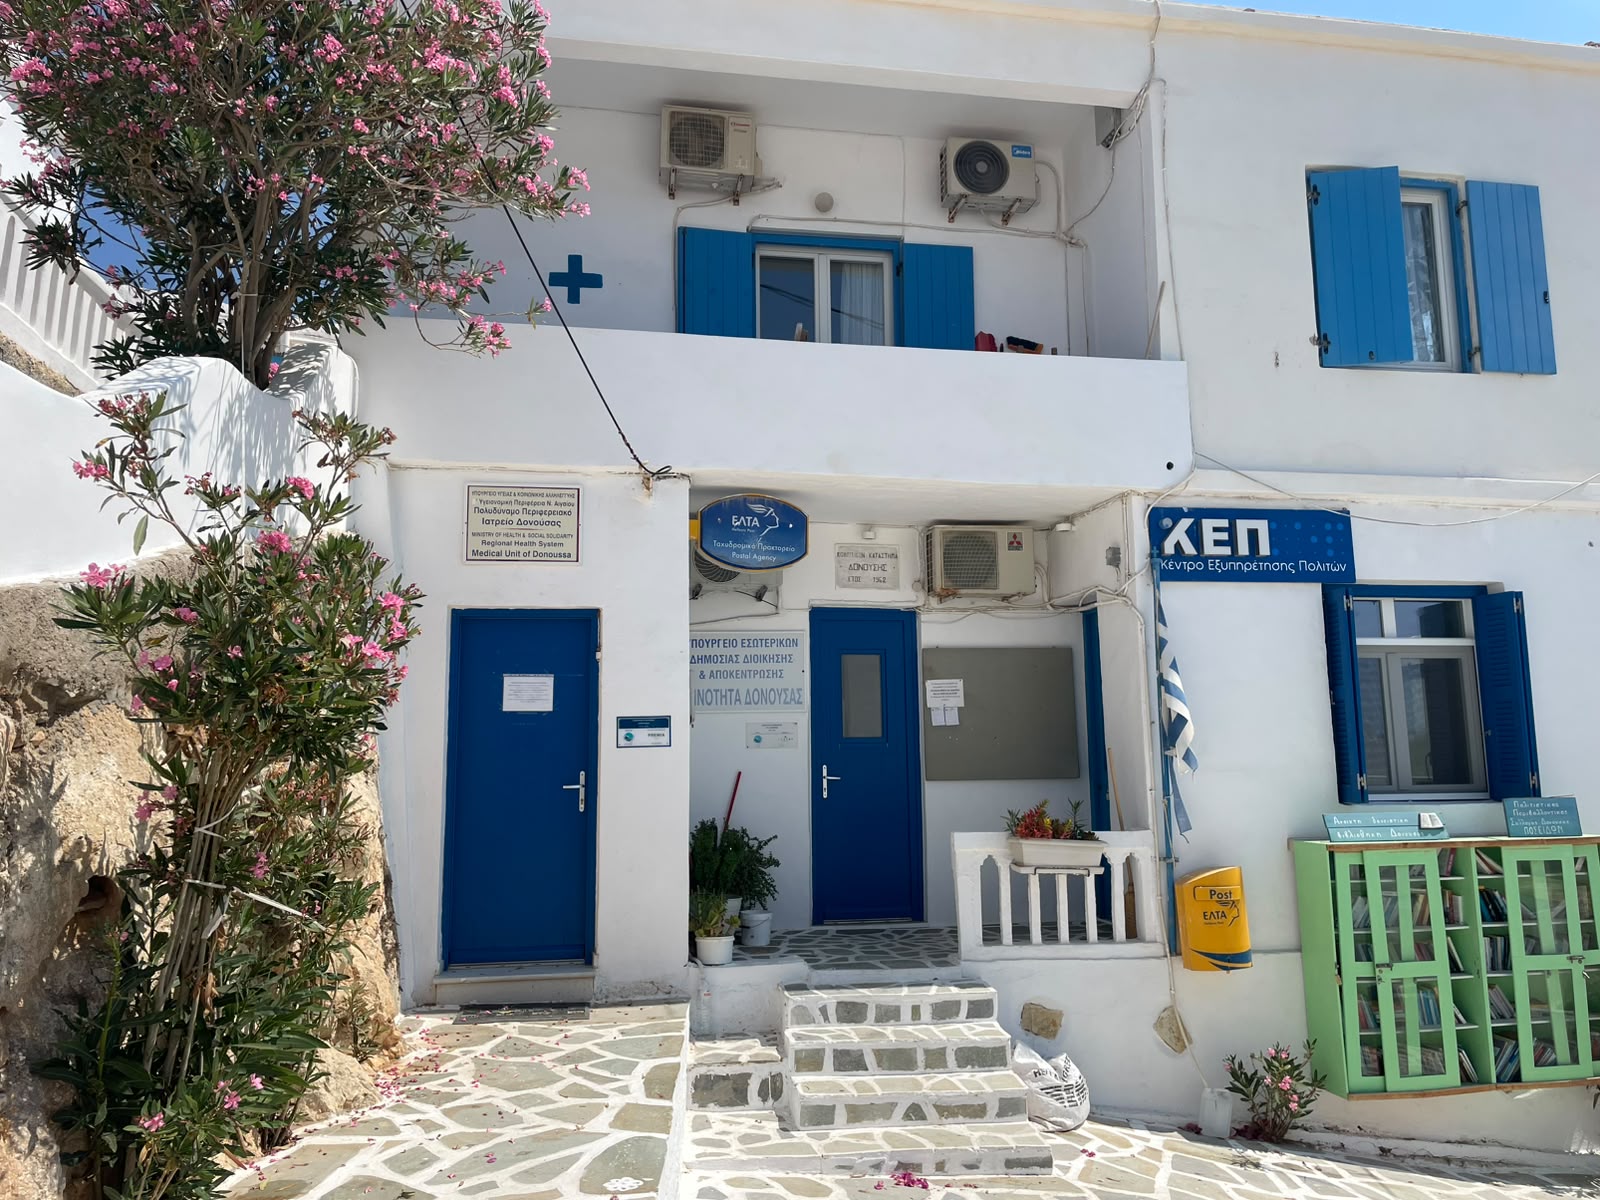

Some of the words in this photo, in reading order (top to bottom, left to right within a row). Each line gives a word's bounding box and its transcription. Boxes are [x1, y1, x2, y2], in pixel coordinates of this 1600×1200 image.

[474, 507, 520, 516] Πολυδύναμο
[522, 507, 572, 517] Περιφερειακό
[482, 517, 514, 527] Ιατρείο
[516, 518, 561, 528] Δονούσας
[732, 515, 760, 527] ΕΛΤΑ
[1161, 517, 1271, 556] ΚΕΠ
[752, 553, 776, 562] Agency
[1161, 559, 1204, 572] Κέντρο
[1208, 560, 1295, 573] Εξυπηρέτησης
[1299, 560, 1346, 572] Πολιτών
[690, 639, 738, 648] ΠΟΥΡΓΕΙΟ
[741, 638, 798, 648] ΕΣΩΤΕΡΙΚΩΝ
[690, 655, 740, 664] ΔΗΜΟΣΙΑΣ
[743, 654, 793, 663] ΔΙΟΙΚΗΣΗΣ
[699, 671, 706, 679] &
[709, 669, 784, 679] ΑΠΟΚΕΝΤΡΩΣΗΣ
[744, 688, 803, 705] ΔΟΝΟΥΣΑΣ
[1209, 890, 1232, 899] Post
[1203, 911, 1227, 920] ΕΛΤΑ
